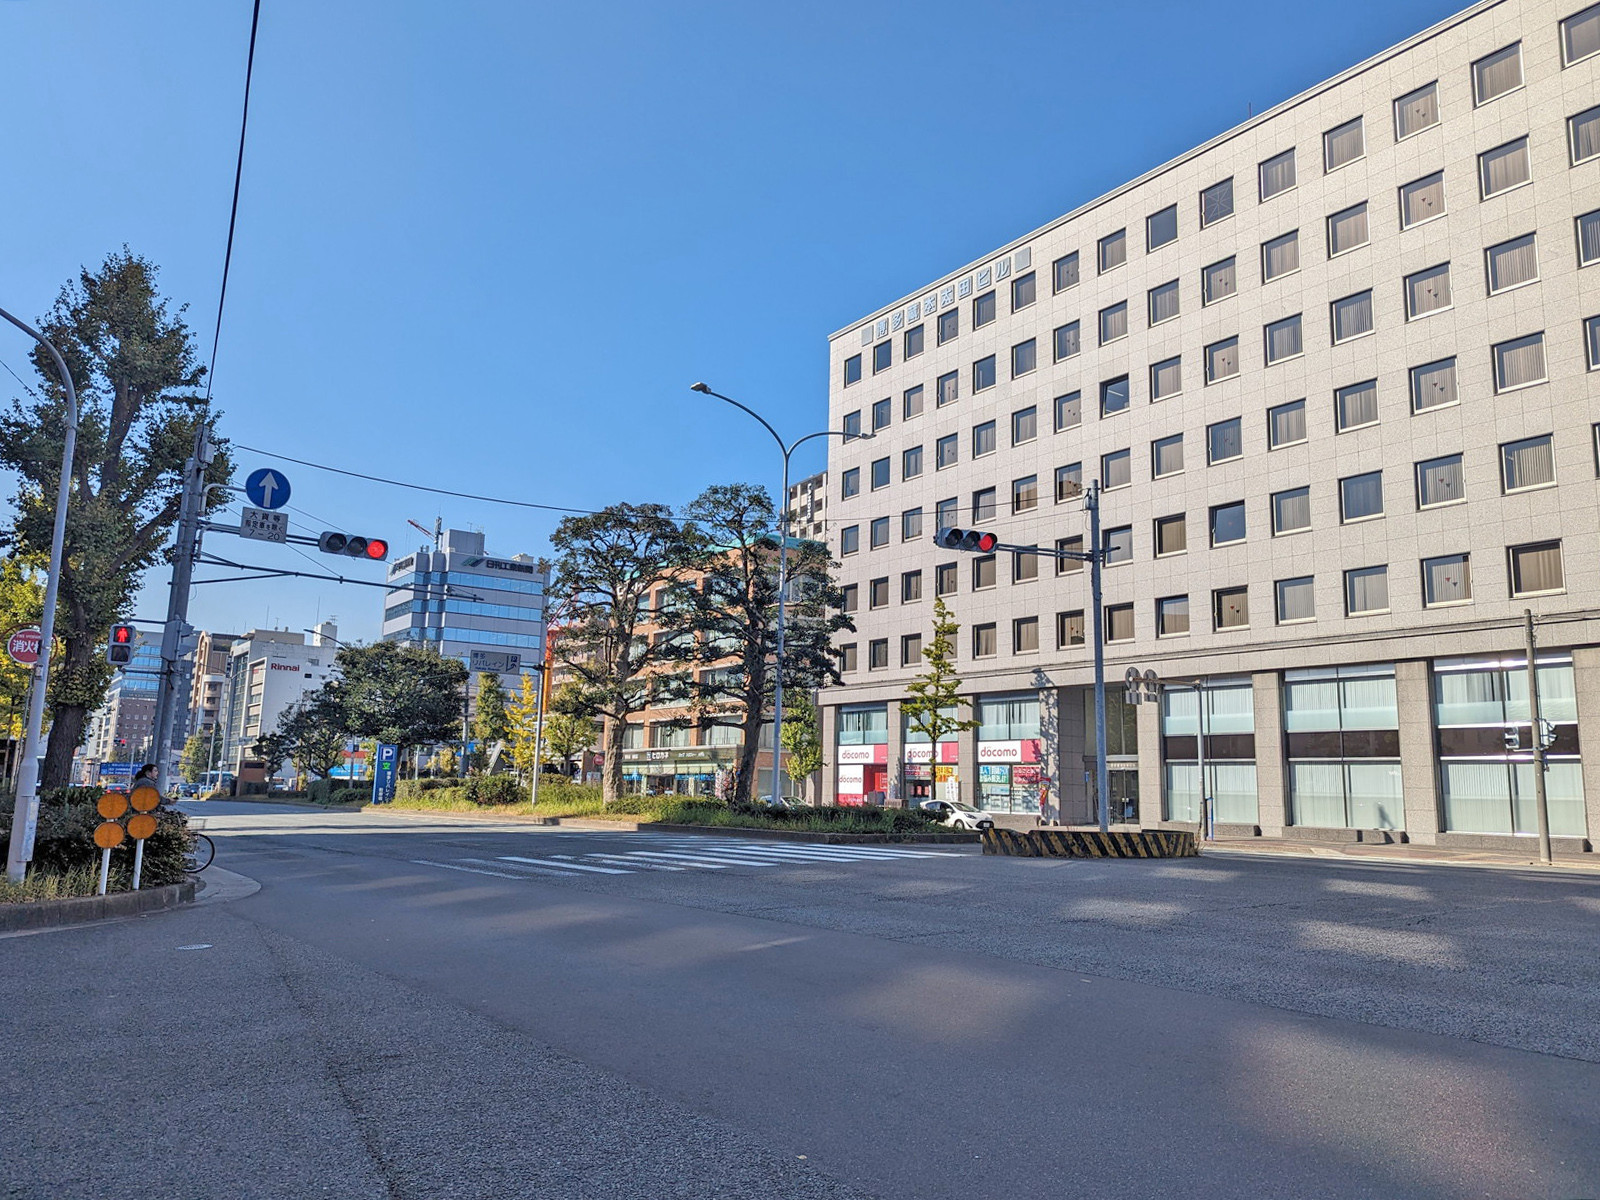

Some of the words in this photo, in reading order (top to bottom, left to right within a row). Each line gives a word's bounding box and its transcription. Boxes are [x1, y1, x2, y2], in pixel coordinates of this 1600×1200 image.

[876, 259, 1010, 336] 博多蔵本太田ビル
[271, 663, 300, 671] Rinnai
[383, 748, 393, 760] P
[842, 751, 870, 760] docomo
[980, 746, 1018, 757] docomo
